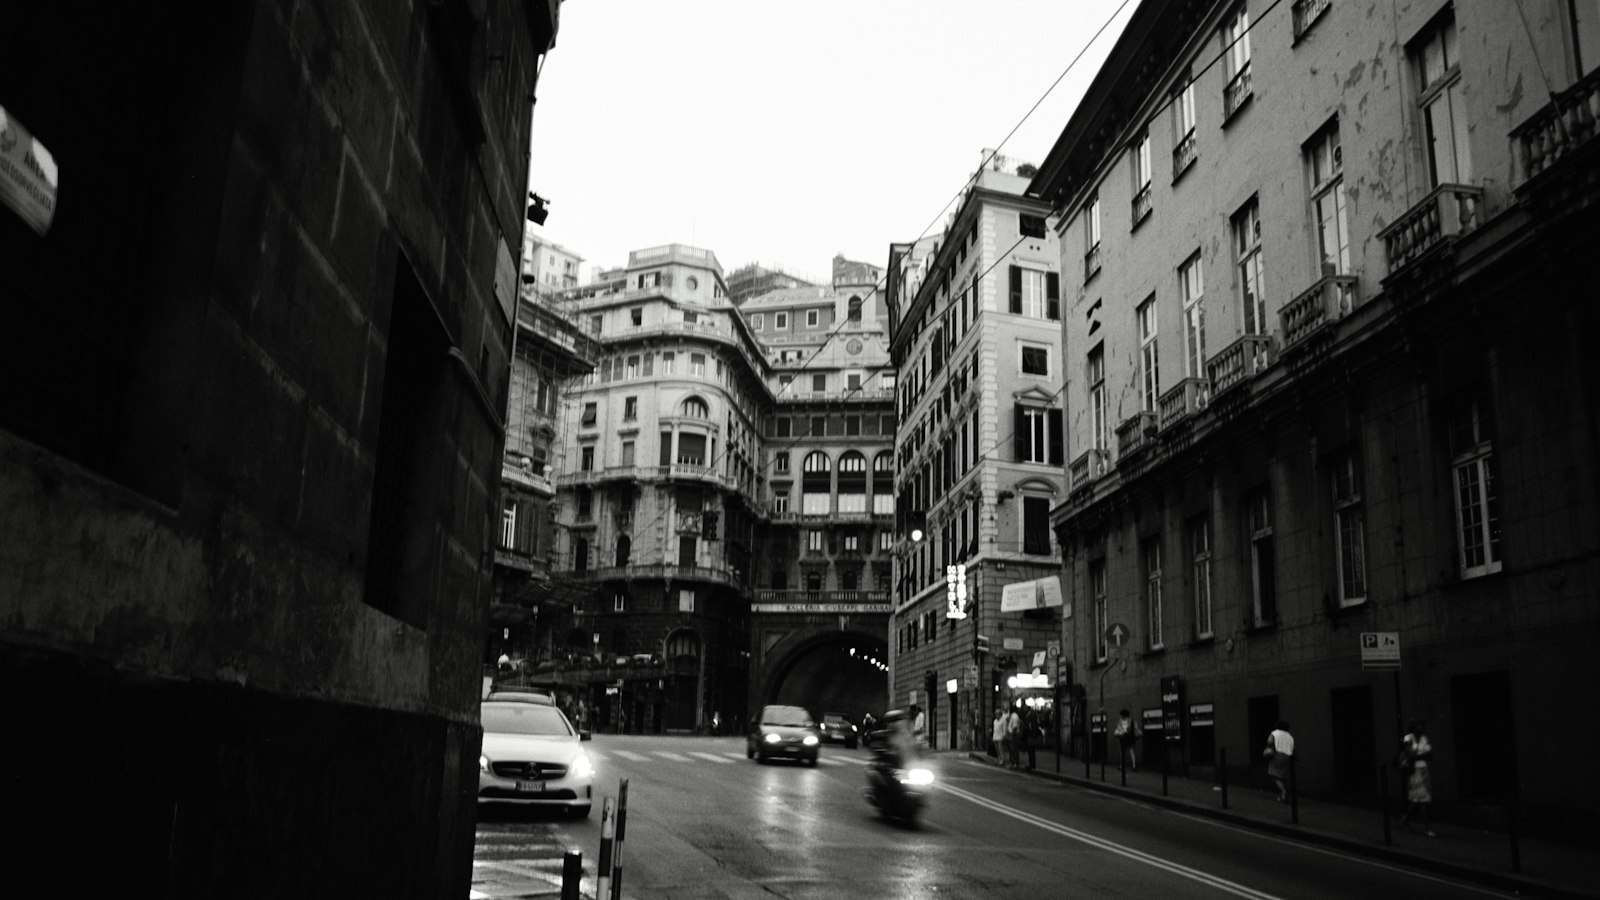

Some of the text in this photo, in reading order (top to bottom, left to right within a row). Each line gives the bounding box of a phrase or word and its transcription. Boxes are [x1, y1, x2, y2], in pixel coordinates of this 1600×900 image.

[23, 151, 47, 183] AREA
[786, 603, 821, 613] GALLERIA
[1366, 635, 1376, 648] P
